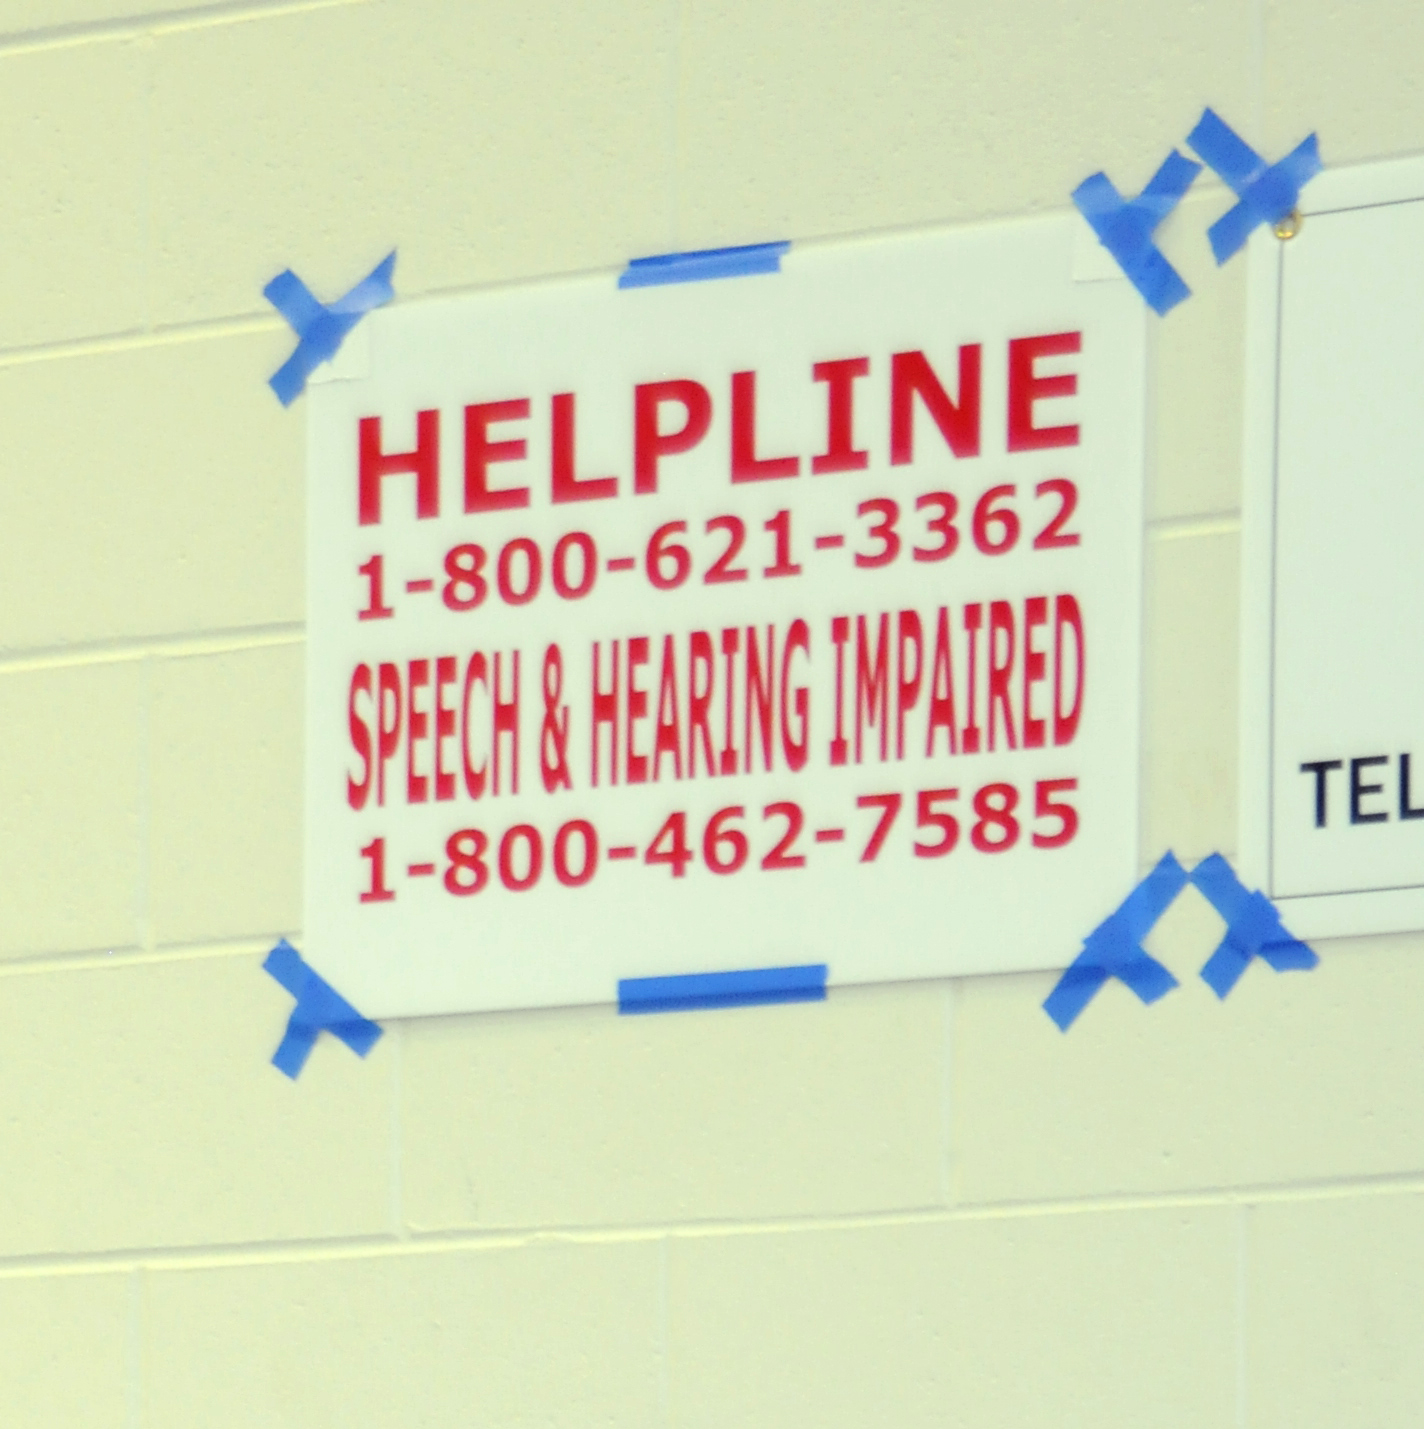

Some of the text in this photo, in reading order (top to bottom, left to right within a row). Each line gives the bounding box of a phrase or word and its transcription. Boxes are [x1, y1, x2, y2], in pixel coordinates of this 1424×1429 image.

[357, 331, 1082, 526] HELPLINE
[358, 478, 1080, 620] 1-800-621-3362
[345, 592, 1086, 812] SPEECH & HEARING IMPAIRED
[358, 778, 1080, 904] 1-800-462-7585
[1299, 753, 1424, 829] TEL
